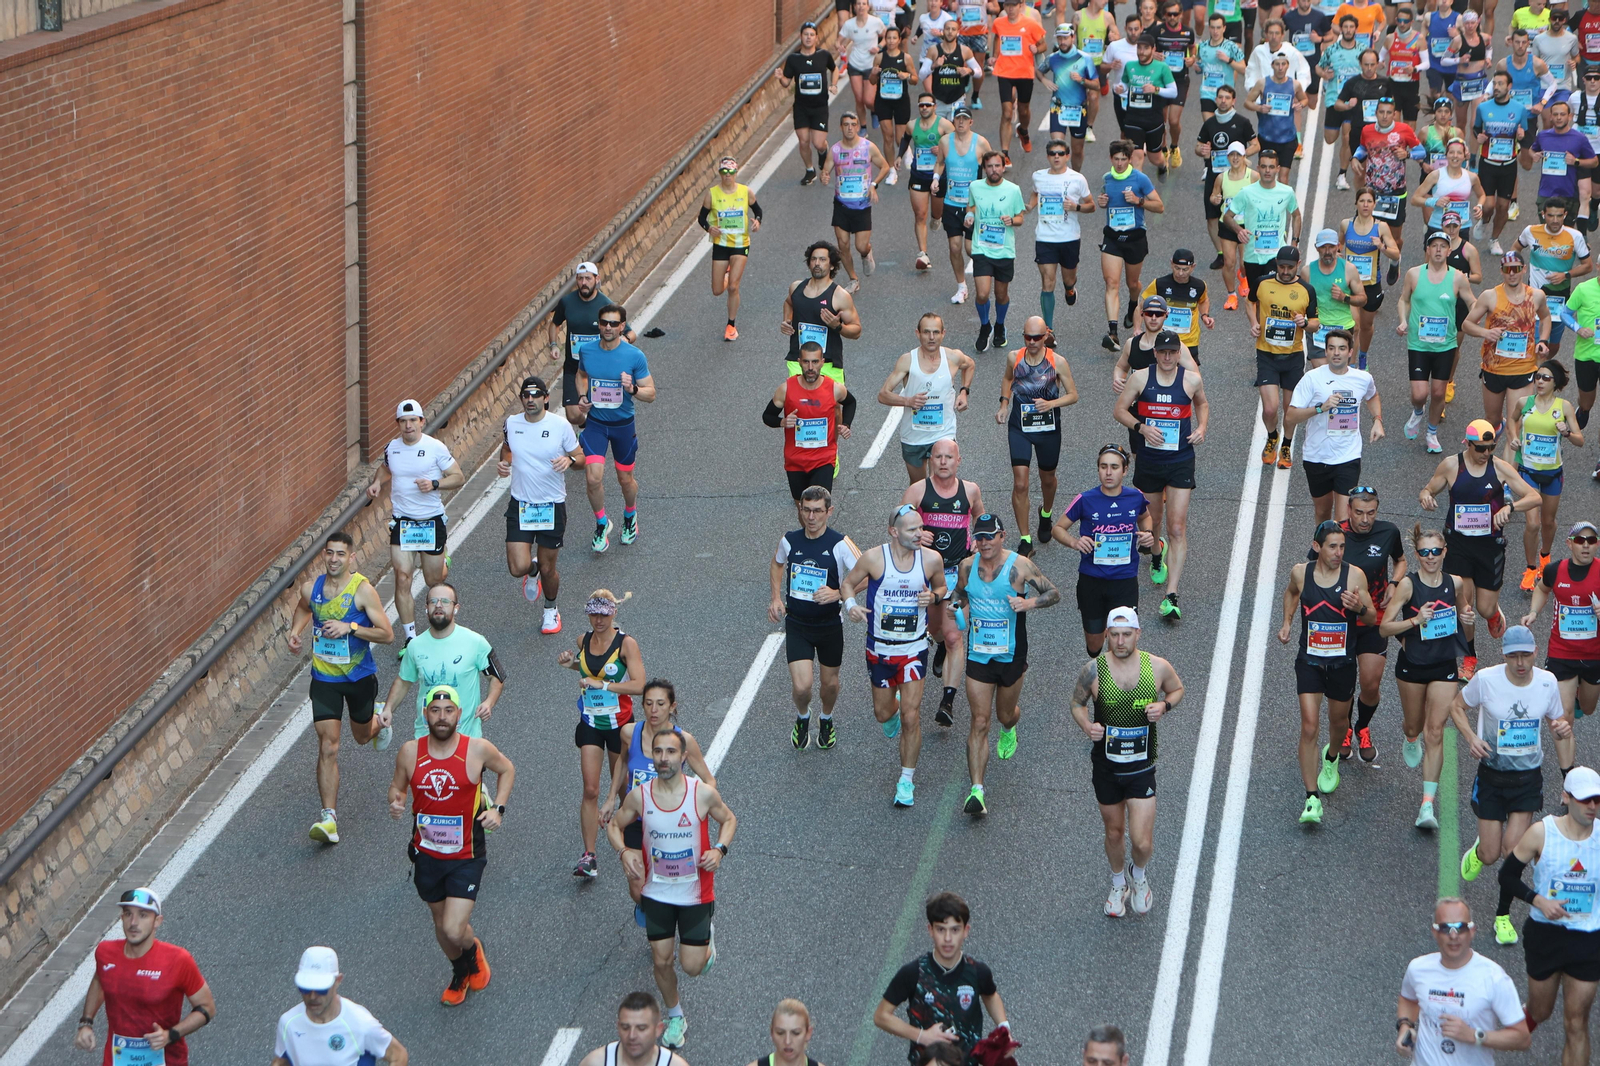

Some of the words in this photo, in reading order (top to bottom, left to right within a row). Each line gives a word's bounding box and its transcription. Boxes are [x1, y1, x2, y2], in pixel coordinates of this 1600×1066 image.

[940, 77, 961, 85] SEVILLA
[1156, 393, 1172, 403] ROB
[802, 567, 823, 576] ZURICH
[1433, 610, 1453, 619] ZURICH
[664, 852, 688, 860] ZURICH
[1566, 884, 1591, 892] ZURICH
[1428, 988, 1465, 999] IRONMAN
[129, 1038, 150, 1047] ZURIC
